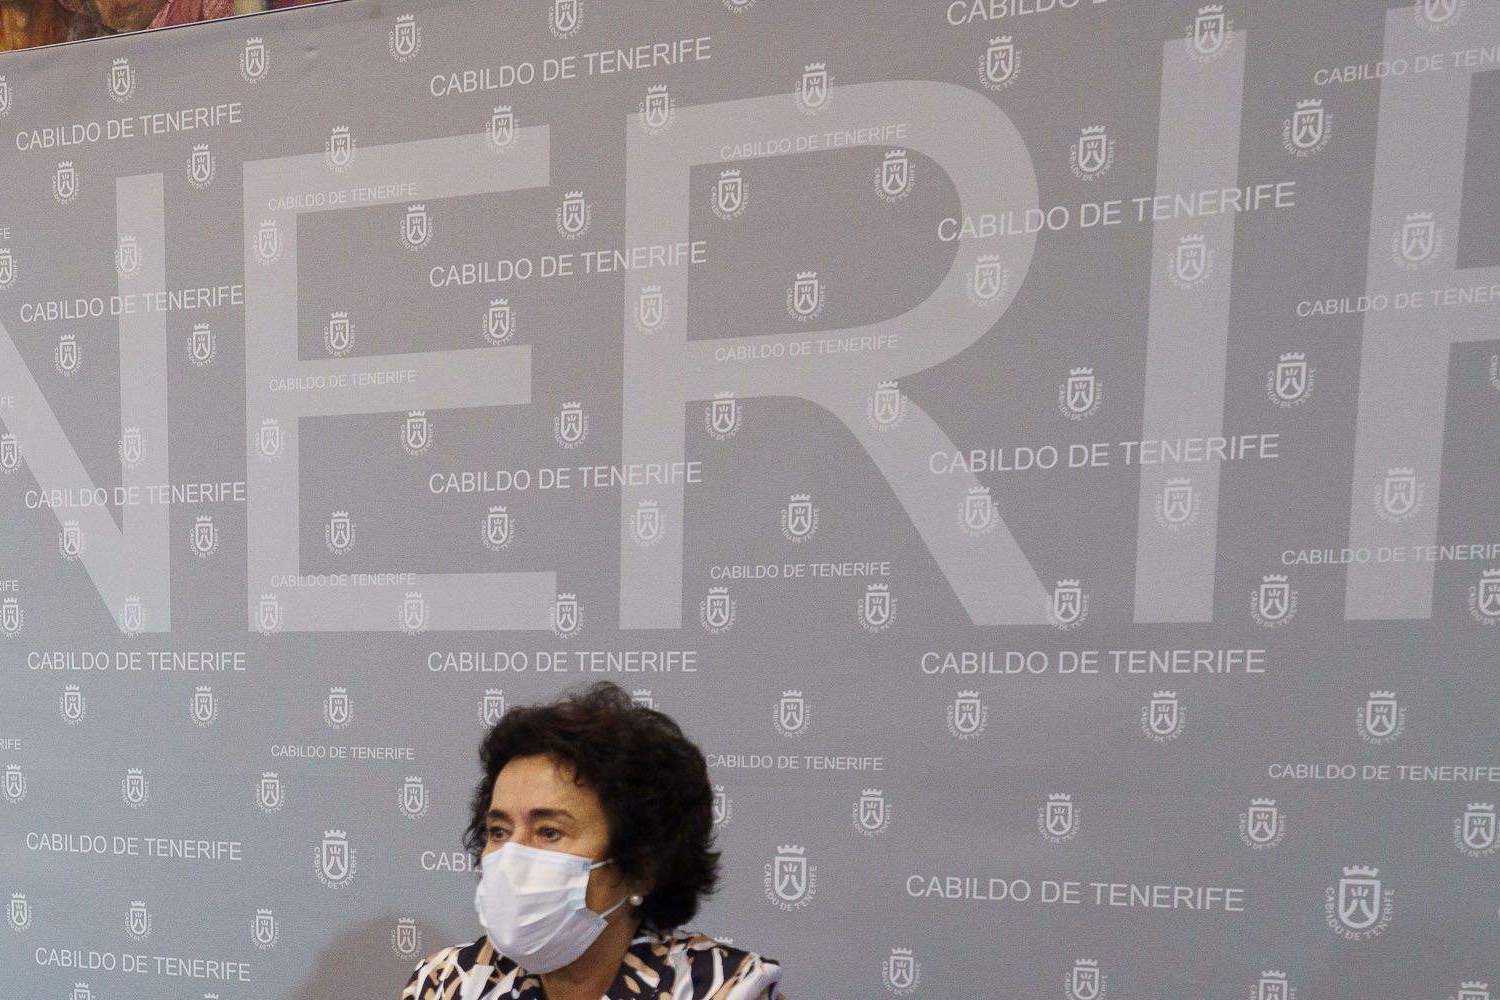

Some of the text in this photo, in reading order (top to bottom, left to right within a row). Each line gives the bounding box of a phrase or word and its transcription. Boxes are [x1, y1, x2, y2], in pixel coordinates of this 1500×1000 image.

[429, 37, 711, 98] CABILDO DE TENERIFE
[1314, 59, 1408, 86] CABILDO
[1414, 54, 1444, 73] DE
[15, 103, 242, 152] CABILDO DE TENERIFE
[719, 123, 906, 160] CABILDO DE TENERIFE
[267, 182, 417, 212] CABILDO DE TENERIFE
[936, 182, 1295, 242] CABILDO DE TENERIFE
[428, 242, 706, 288] CABILDO DE TENERIFE
[19, 285, 243, 323] CABILDO DE TENERIFE
[1296, 294, 1389, 317] CABILDO
[1394, 291, 1423, 309] DE
[714, 334, 897, 362] CABILDO DE TENERIFE
[268, 370, 416, 391] CABILDO DE TENERIFE
[928, 434, 1279, 475] CABILDO DE TENERIFE
[428, 462, 702, 495] CABILDO DE TENERIFE
[24, 482, 245, 509] CABILDO DE TENERIFE
[1281, 548, 1371, 565] CABILDO
[1378, 547, 1406, 563] DE
[270, 573, 416, 588] CABILDO DE TENERIFE
[709, 562, 890, 579] CABILDO DE TENERIFE
[26, 651, 246, 672] CABILDO DE TENERIFE
[426, 652, 697, 673] CABILDO DE TENERIFE
[920, 649, 1265, 675] CABILDO DE TENERIFE
[270, 745, 415, 760] CABILDO DE TENERIFE
[706, 753, 883, 771] CABILDO DE TENERIFE
[1267, 764, 1500, 783] CABILDO DE TENERIFE
[25, 832, 242, 861] CABILDO DE TENERIFE
[421, 851, 483, 873] CABI
[905, 874, 1244, 912] CABILDO DE TENERIFE
[34, 946, 250, 982] CABILDO DE TENERIFE
